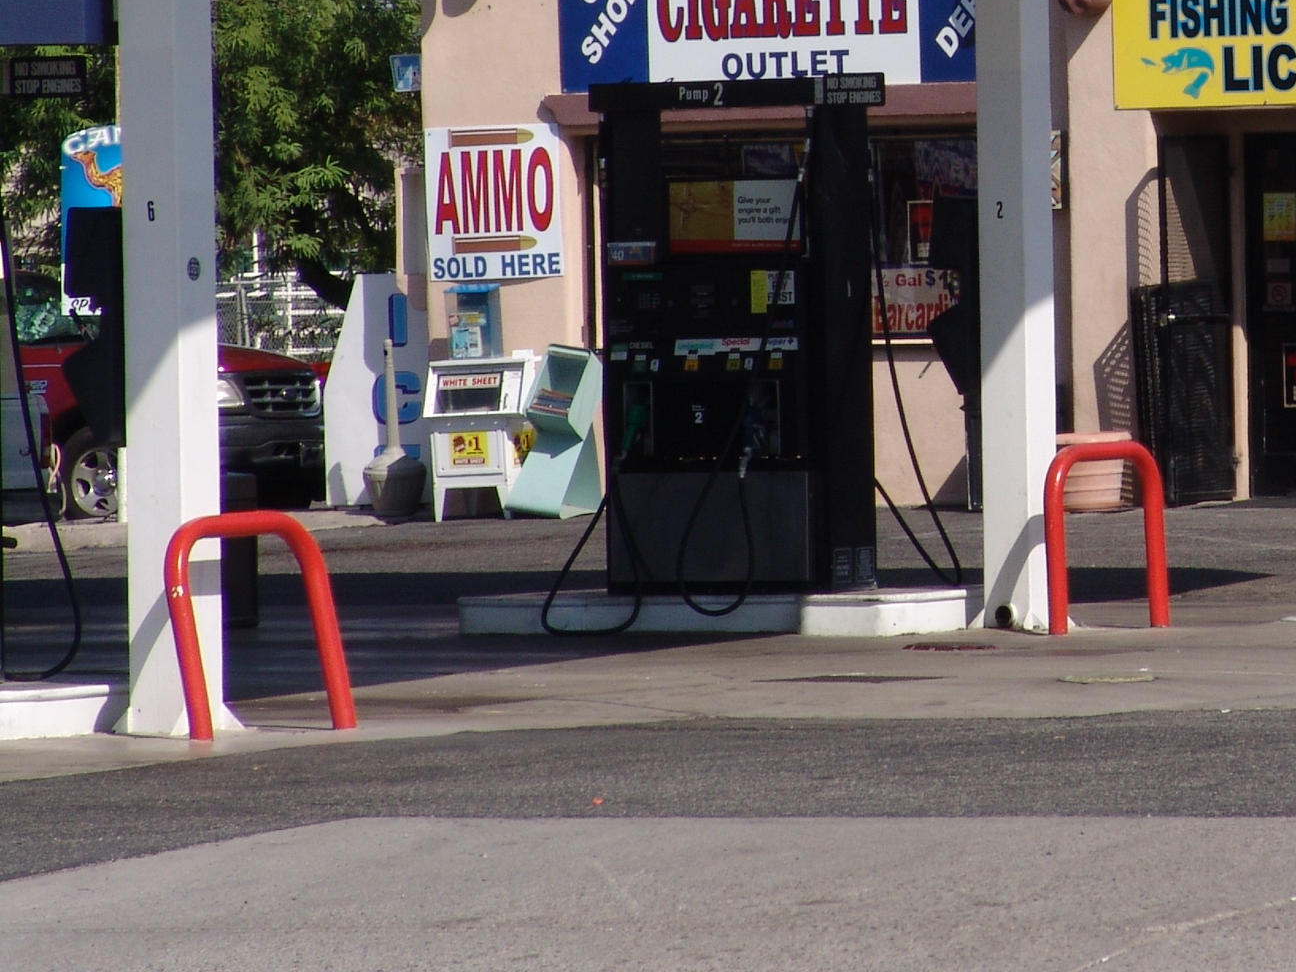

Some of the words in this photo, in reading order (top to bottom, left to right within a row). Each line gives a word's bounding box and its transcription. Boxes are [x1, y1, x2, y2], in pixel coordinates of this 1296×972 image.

[14, 62, 28, 76] NO
[31, 61, 76, 76] SMOKING
[721, 49, 850, 79] OUTLET
[14, 80, 40, 94] STOP
[41, 78, 82, 93] ENGINES
[827, 77, 838, 89] NO
[839, 76, 877, 88] SMOKING
[678, 86, 709, 101] Pump
[713, 83, 723, 105] 2
[827, 91, 848, 104] STOP
[849, 91, 881, 104] ENGINES
[435, 146, 554, 235] AMMO
[737, 196, 754, 204] Give
[147, 200, 155, 222] 6
[769, 206, 781, 215] gift
[996, 201, 1004, 219] 2
[433, 255, 487, 279] SOLD
[501, 252, 560, 276] HERE
[772, 280, 787, 290] PY
[895, 274, 922, 287] Gal
[767, 291, 793, 302] FST
[71, 298, 90, 311] SP
[721, 337, 750, 346] Special
[372, 293, 421, 460] IC
[442, 378, 468, 387] WHITE
[471, 376, 498, 386] SHEET
[694, 411, 703, 424] 2
